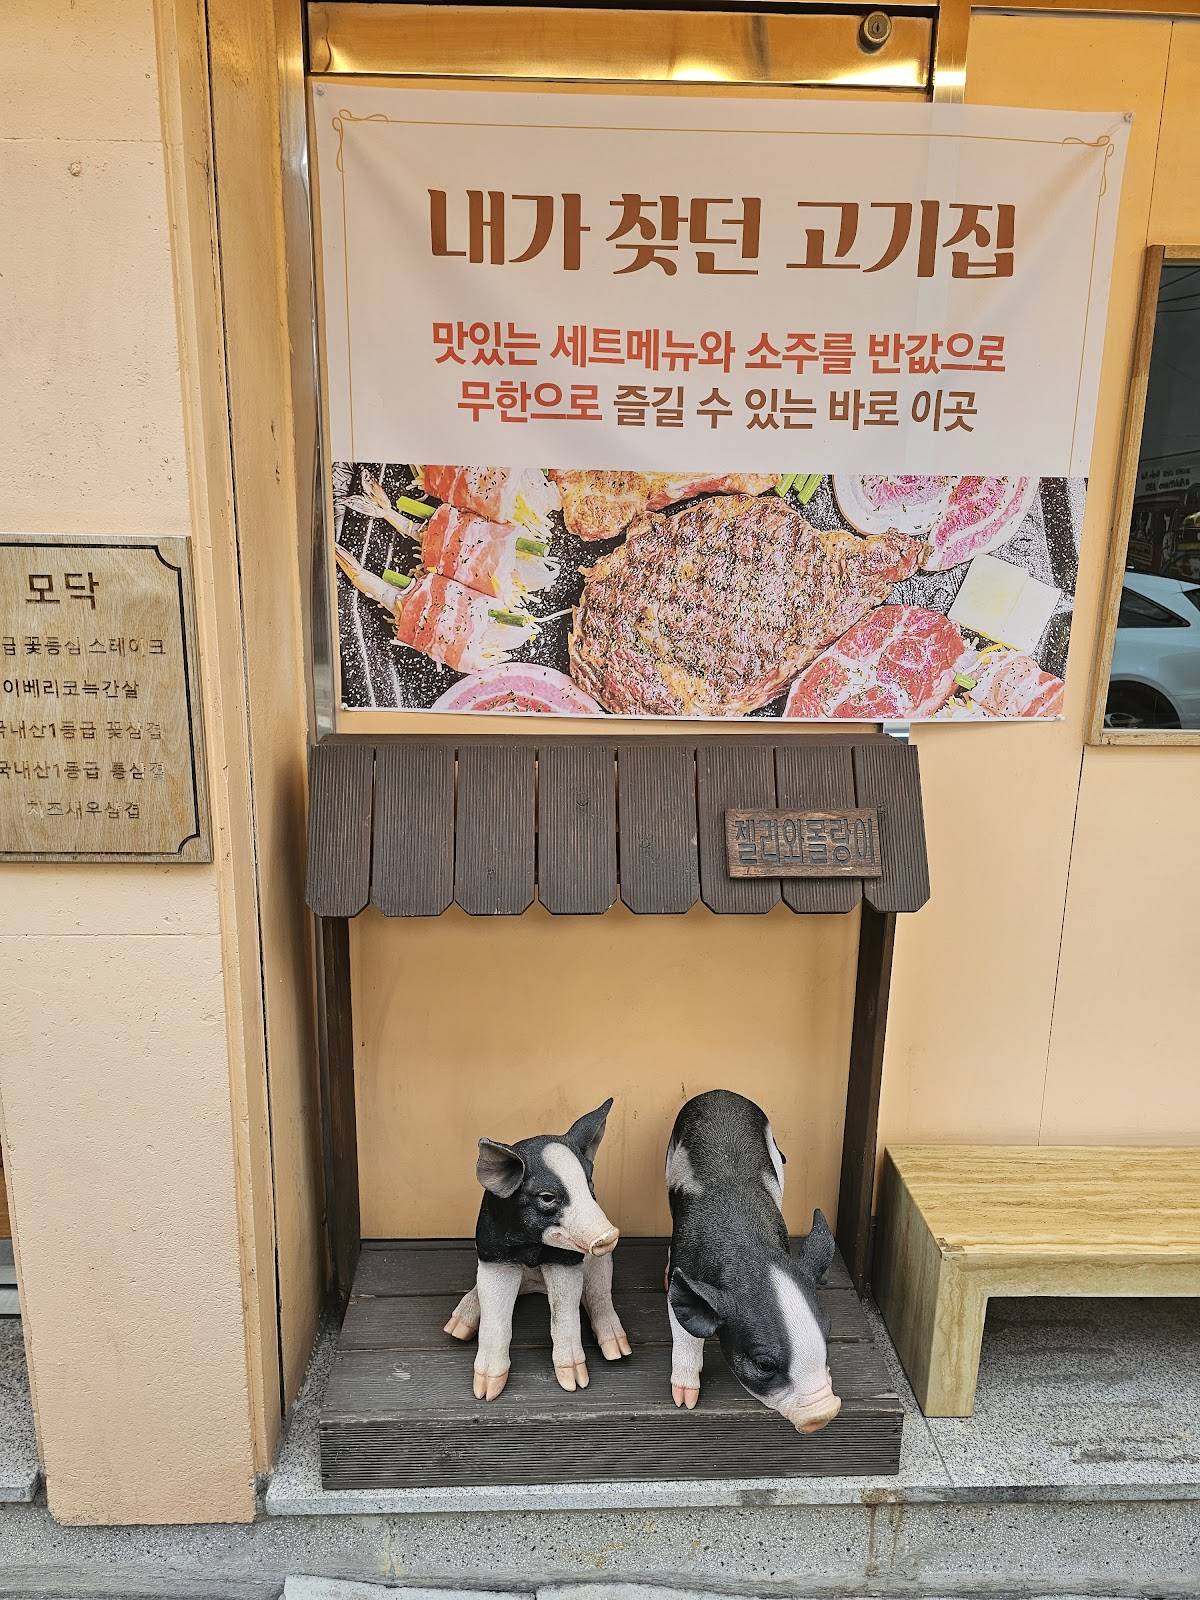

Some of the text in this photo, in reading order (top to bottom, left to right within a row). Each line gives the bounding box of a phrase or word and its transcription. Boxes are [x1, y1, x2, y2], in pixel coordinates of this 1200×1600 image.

[427, 188, 1016, 279] 내가 찾던 고기집
[432, 320, 1006, 375] 맛있는 세트메뉴와 소주를 반값으로
[457, 380, 978, 432] 무한으로 즐길 수 있는 바로 이곳
[25, 571, 100, 610] 모닥
[88, 637, 167, 657] 스테이크
